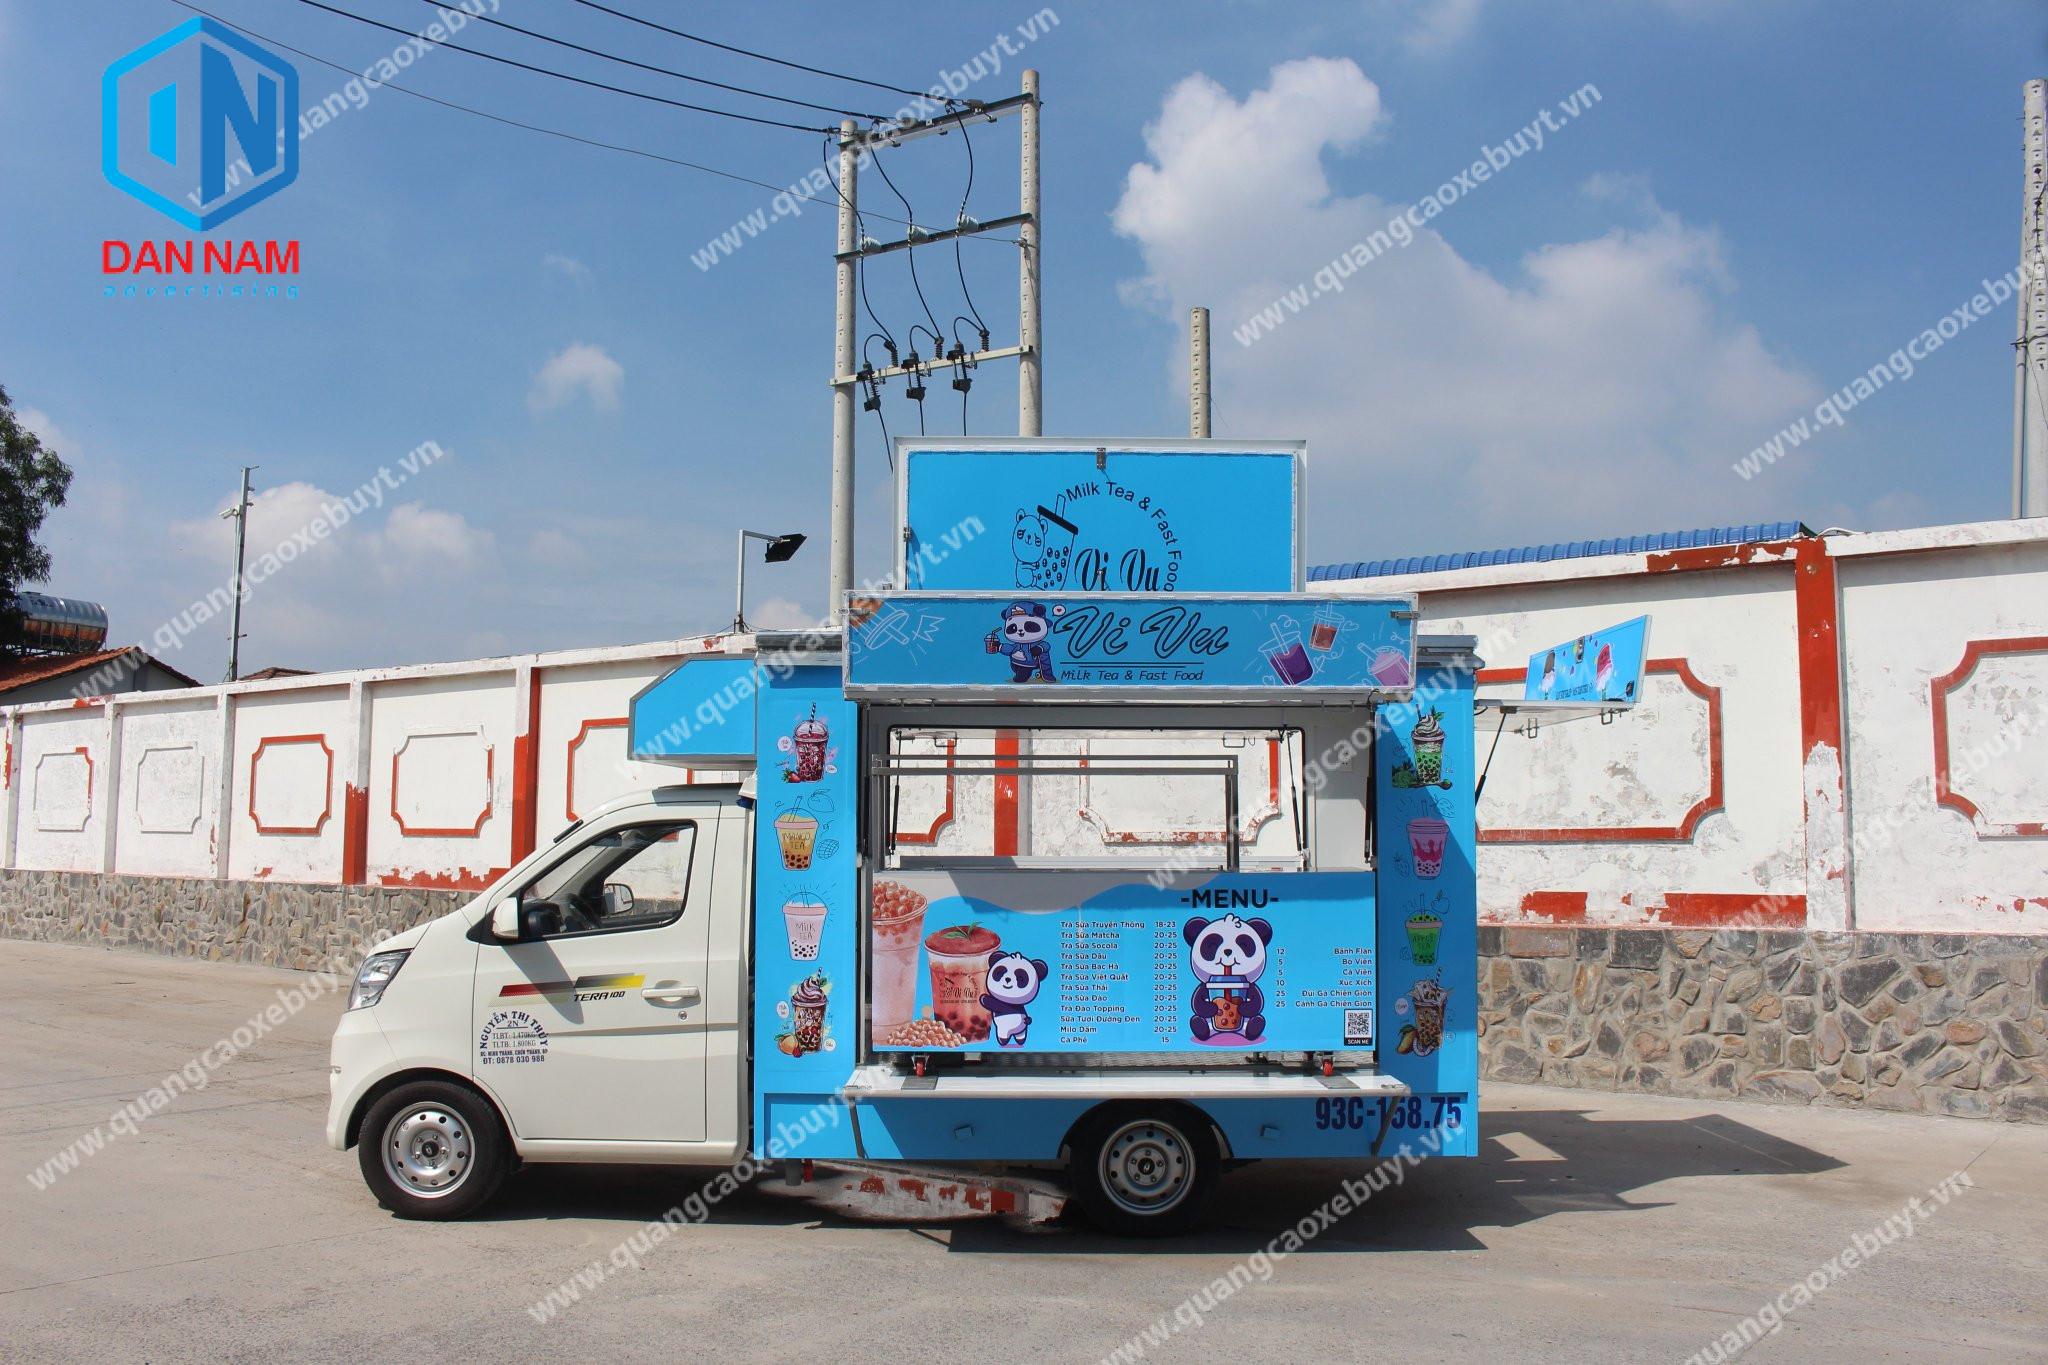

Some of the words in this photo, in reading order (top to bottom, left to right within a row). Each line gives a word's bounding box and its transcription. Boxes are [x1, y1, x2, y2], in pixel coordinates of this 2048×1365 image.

[1065, 481, 1100, 502] Milk
[1106, 481, 1135, 503] Tea
[1138, 496, 1151, 513] &
[1150, 508, 1179, 546] Fast
[1074, 548, 1109, 591] Vi
[1119, 548, 1160, 591] Vu
[1053, 605, 1131, 660] Vi
[1139, 605, 1230, 660] Vu
[1098, 670, 1119, 681] Tea
[1124, 670, 1134, 681] &
[1139, 670, 1168, 681] Fast
[1174, 670, 1203, 681] Food
[1155, 920, 1175, 928] 18-23
[1092, 930, 1119, 939] Matcha
[1154, 931, 1177, 939] 20-25
[1092, 941, 1117, 949] Socola
[1154, 941, 1177, 949] 20-25
[1154, 952, 1177, 960] 20-25
[1154, 962, 1177, 970] 20-25
[1154, 973, 1177, 981] 20-25
[1154, 983, 1177, 991] 20-25
[1276, 979, 1284, 987] 10
[573, 993, 610, 1003] TERA
[609, 990, 626, 999] 100
[1154, 994, 1177, 1002] 20-25
[1276, 1000, 1285, 1008] 25
[1094, 1004, 1124, 1013] Topping
[1154, 1004, 1177, 1012] 20-25
[1154, 1015, 1177, 1023] 20-25
[1060, 1025, 1076, 1033] Milo
[1154, 1025, 1177, 1033] 20-25
[1162, 1036, 1169, 1044] 15
[516, 1055, 530, 1063] 030
